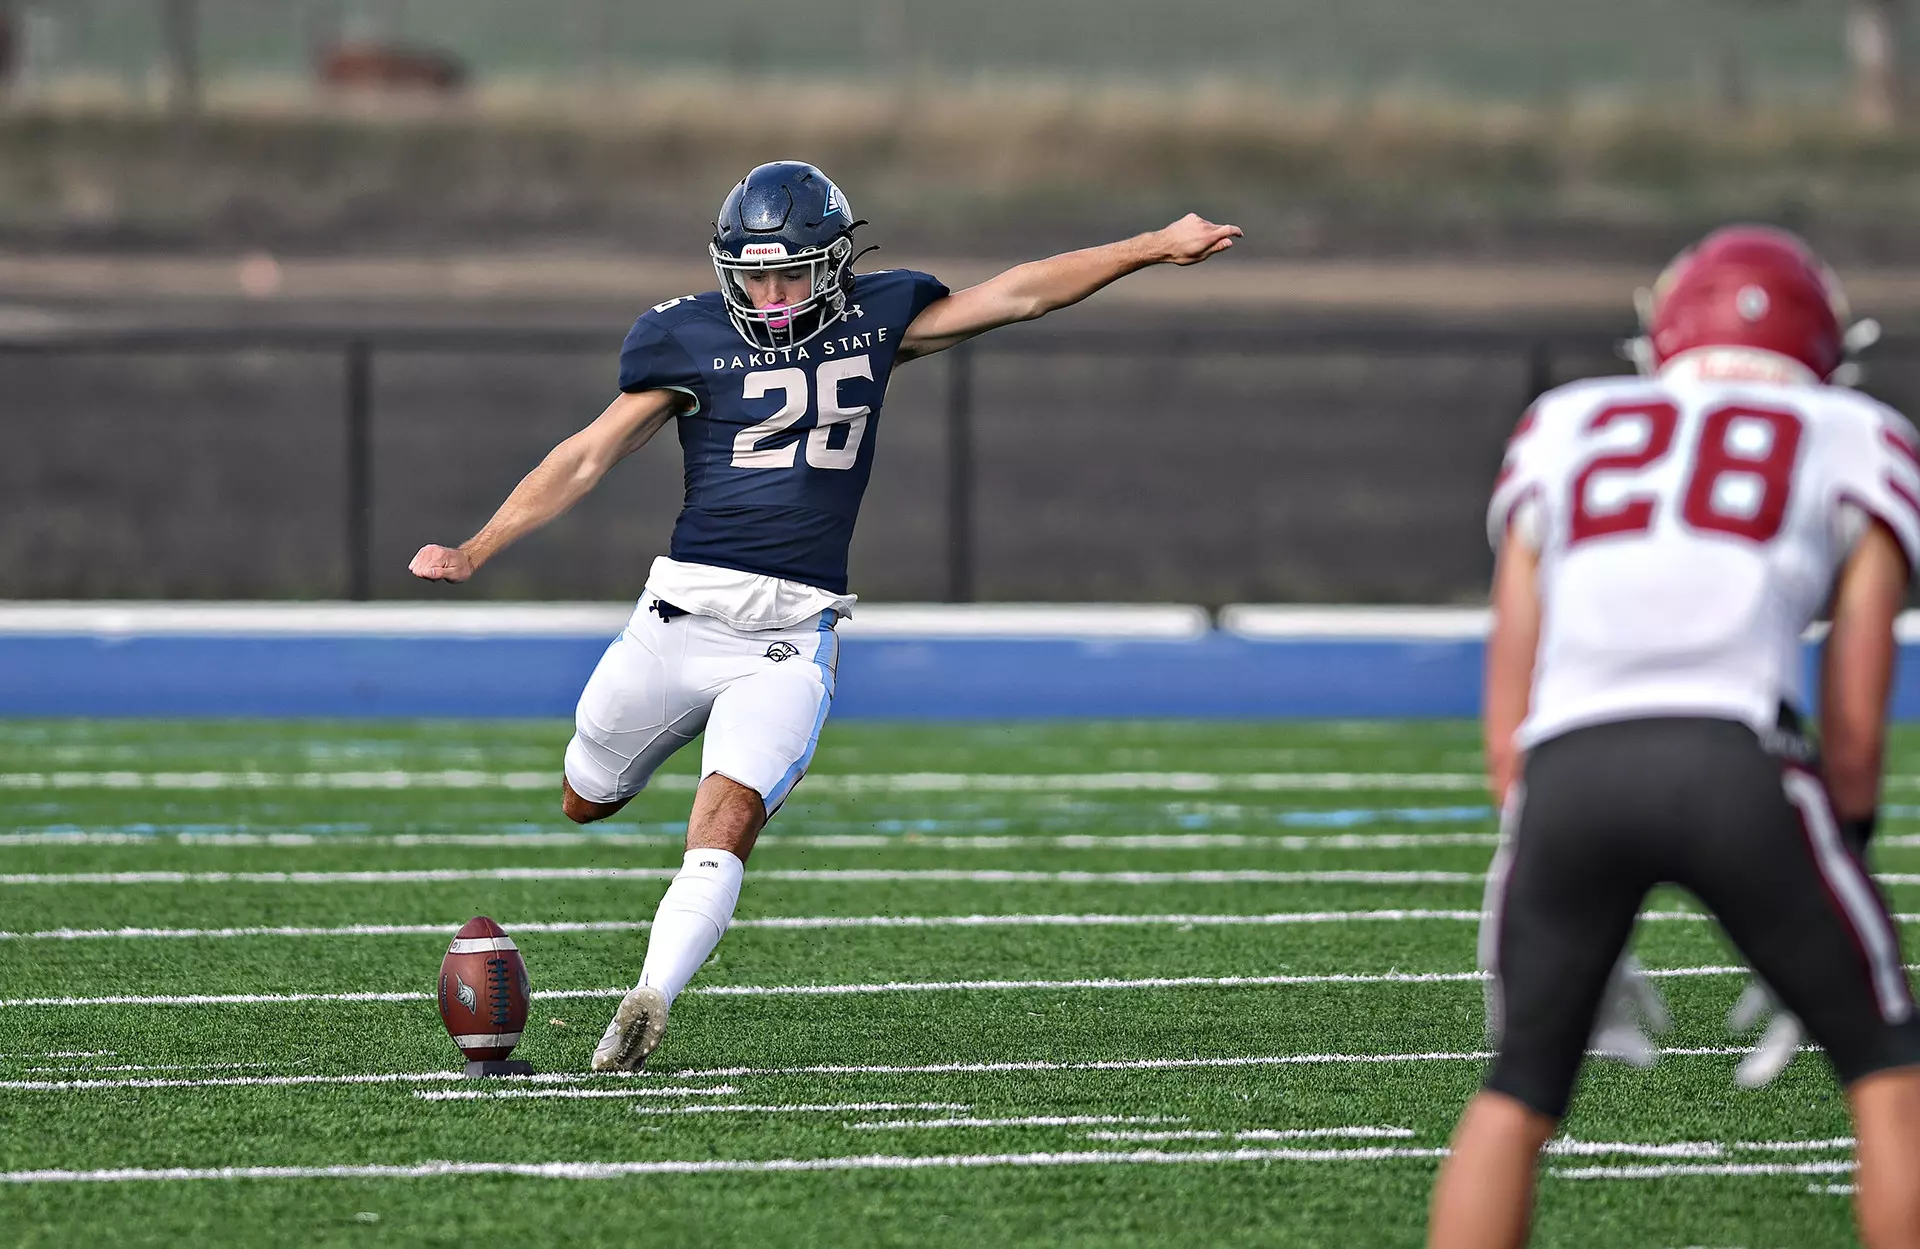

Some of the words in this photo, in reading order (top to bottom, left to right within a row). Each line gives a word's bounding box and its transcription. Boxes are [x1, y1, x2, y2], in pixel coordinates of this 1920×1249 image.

[745, 247, 781, 255] Riddell
[713, 346, 811, 370] DAKOTA
[823, 327, 888, 355] STATE
[729, 353, 875, 471] 26
[1567, 402, 1804, 548] 28
